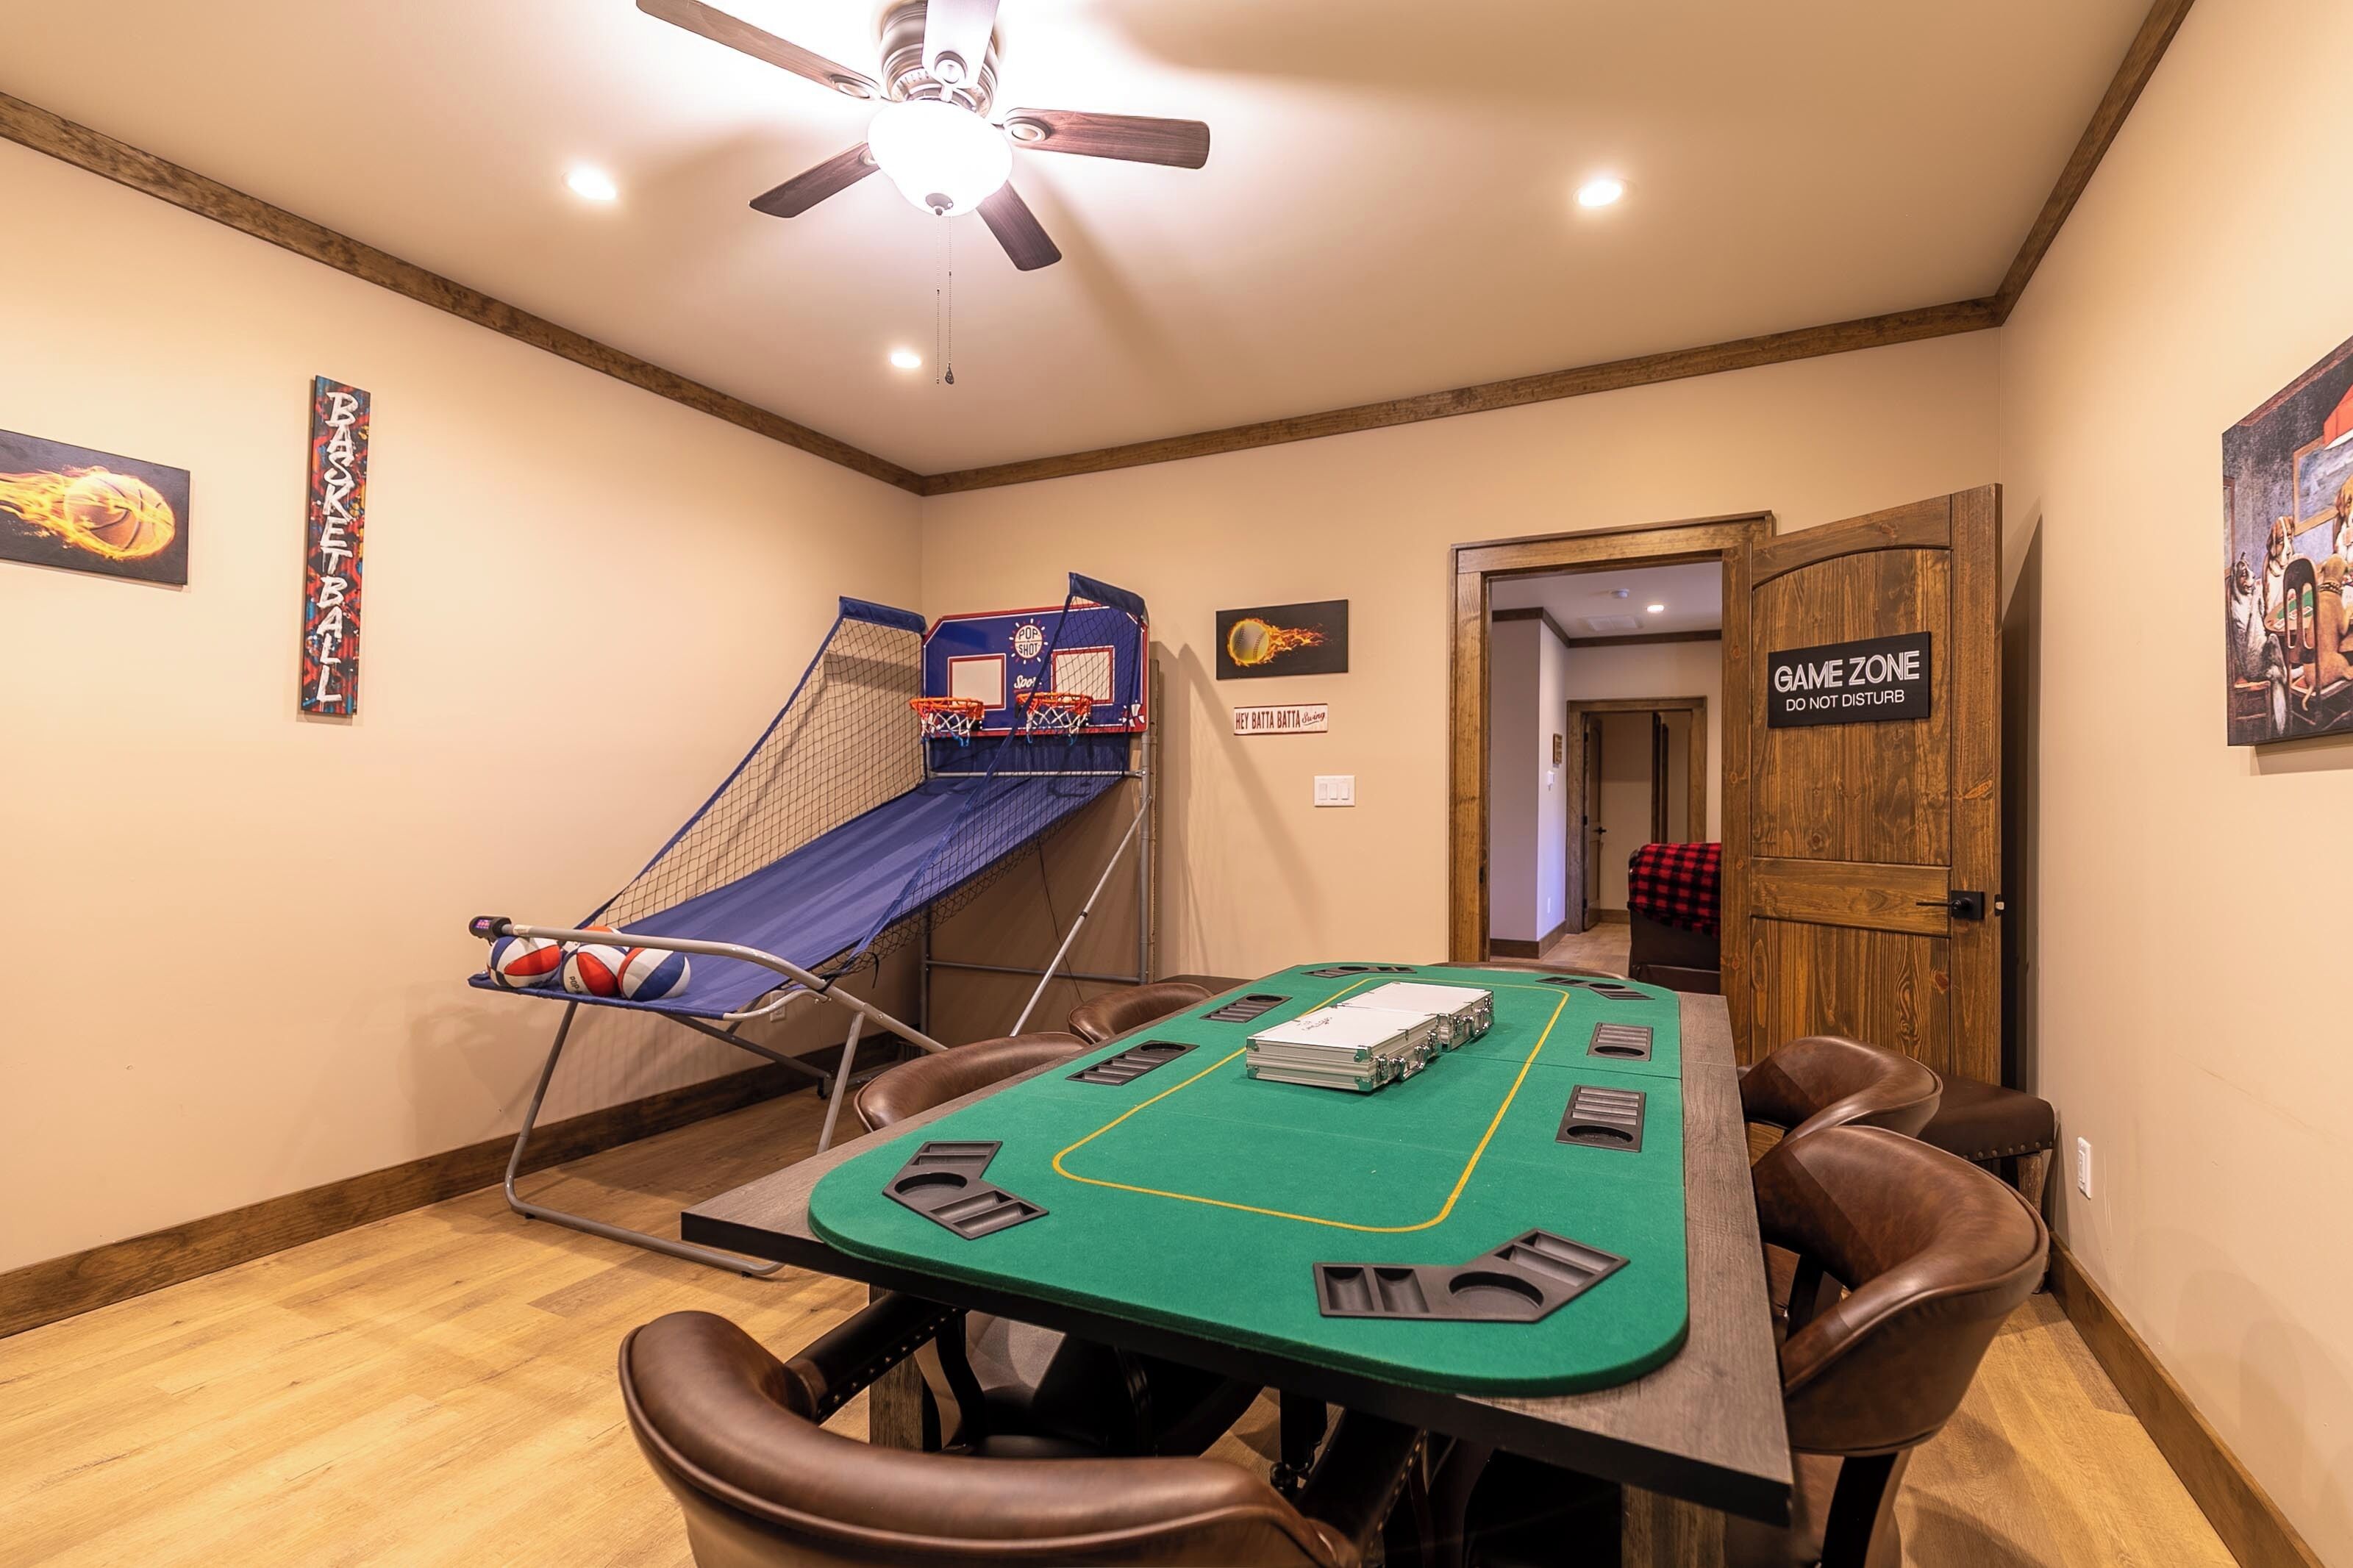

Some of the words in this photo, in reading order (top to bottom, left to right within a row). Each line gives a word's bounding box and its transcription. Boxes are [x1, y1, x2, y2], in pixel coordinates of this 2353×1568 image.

[316, 391, 358, 703] BASKETBALL
[1018, 627, 1038, 640] POP
[1018, 643, 1038, 656] SHOT
[1774, 659, 1843, 692] GAME
[1849, 651, 1920, 686] ZONE
[1786, 698, 1806, 712] DO
[1810, 695, 1838, 709] NOT
[1842, 690, 1905, 707] DISTURB
[1235, 712, 1249, 729] HEY
[1252, 711, 1274, 729] BATTA
[1277, 710, 1301, 728] BATTA
[1302, 712, 1326, 724] Swing
